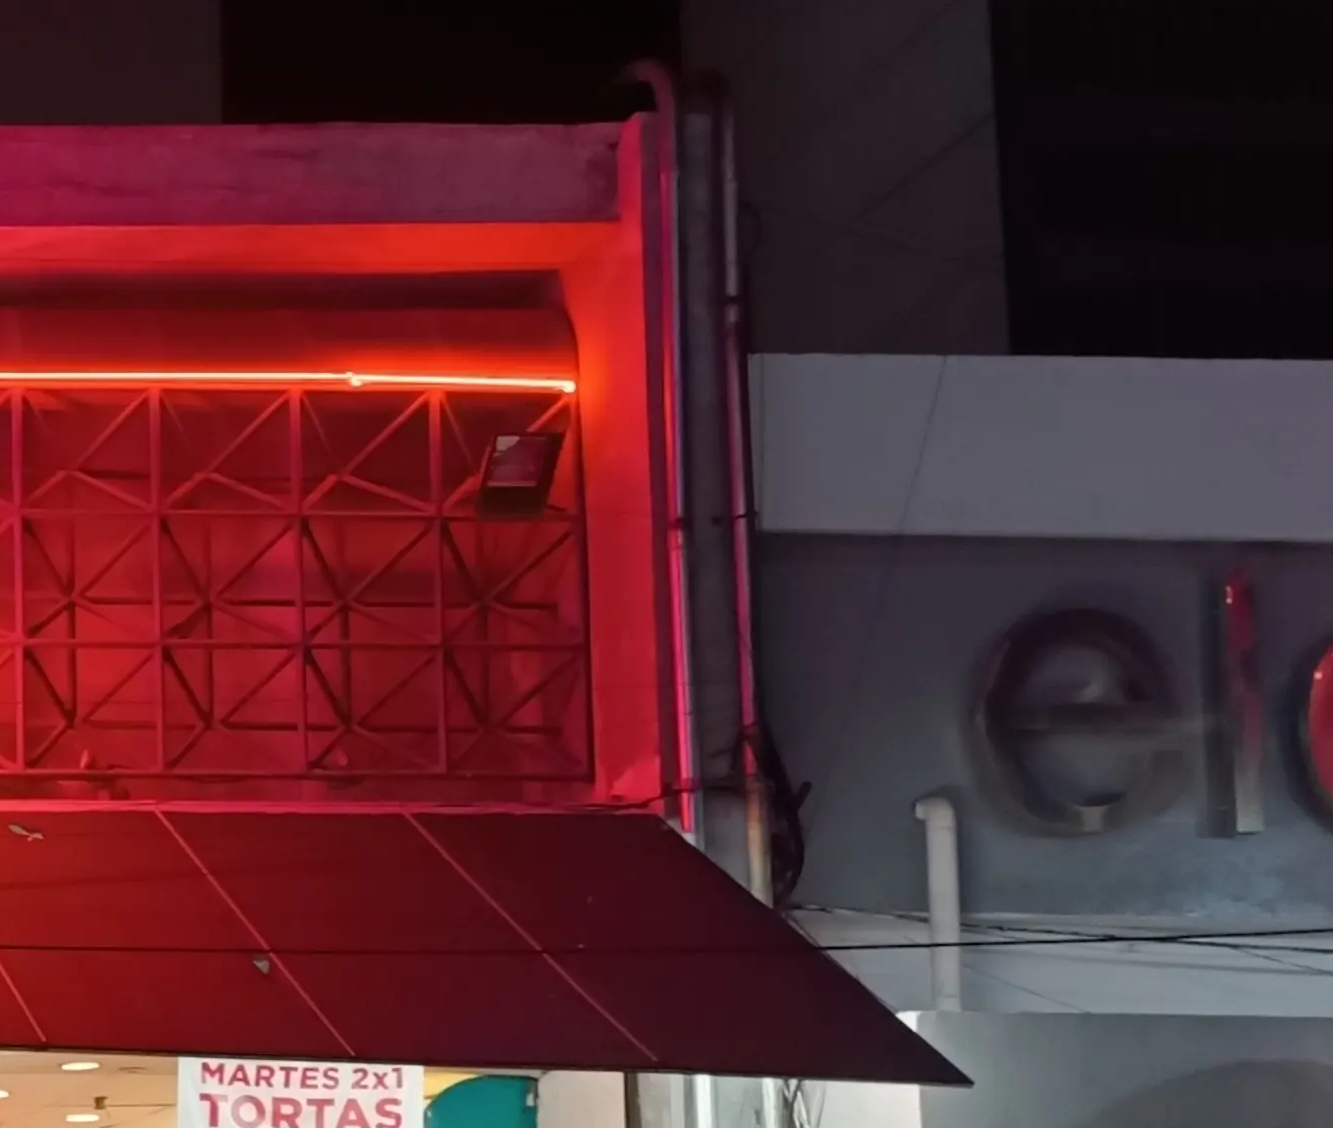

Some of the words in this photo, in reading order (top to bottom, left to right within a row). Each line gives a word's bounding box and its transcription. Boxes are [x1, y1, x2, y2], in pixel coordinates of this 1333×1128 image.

[969, 566, 1333, 840] el
[200, 1062, 340, 1091] MARTES
[351, 1066, 404, 1090] 2x1
